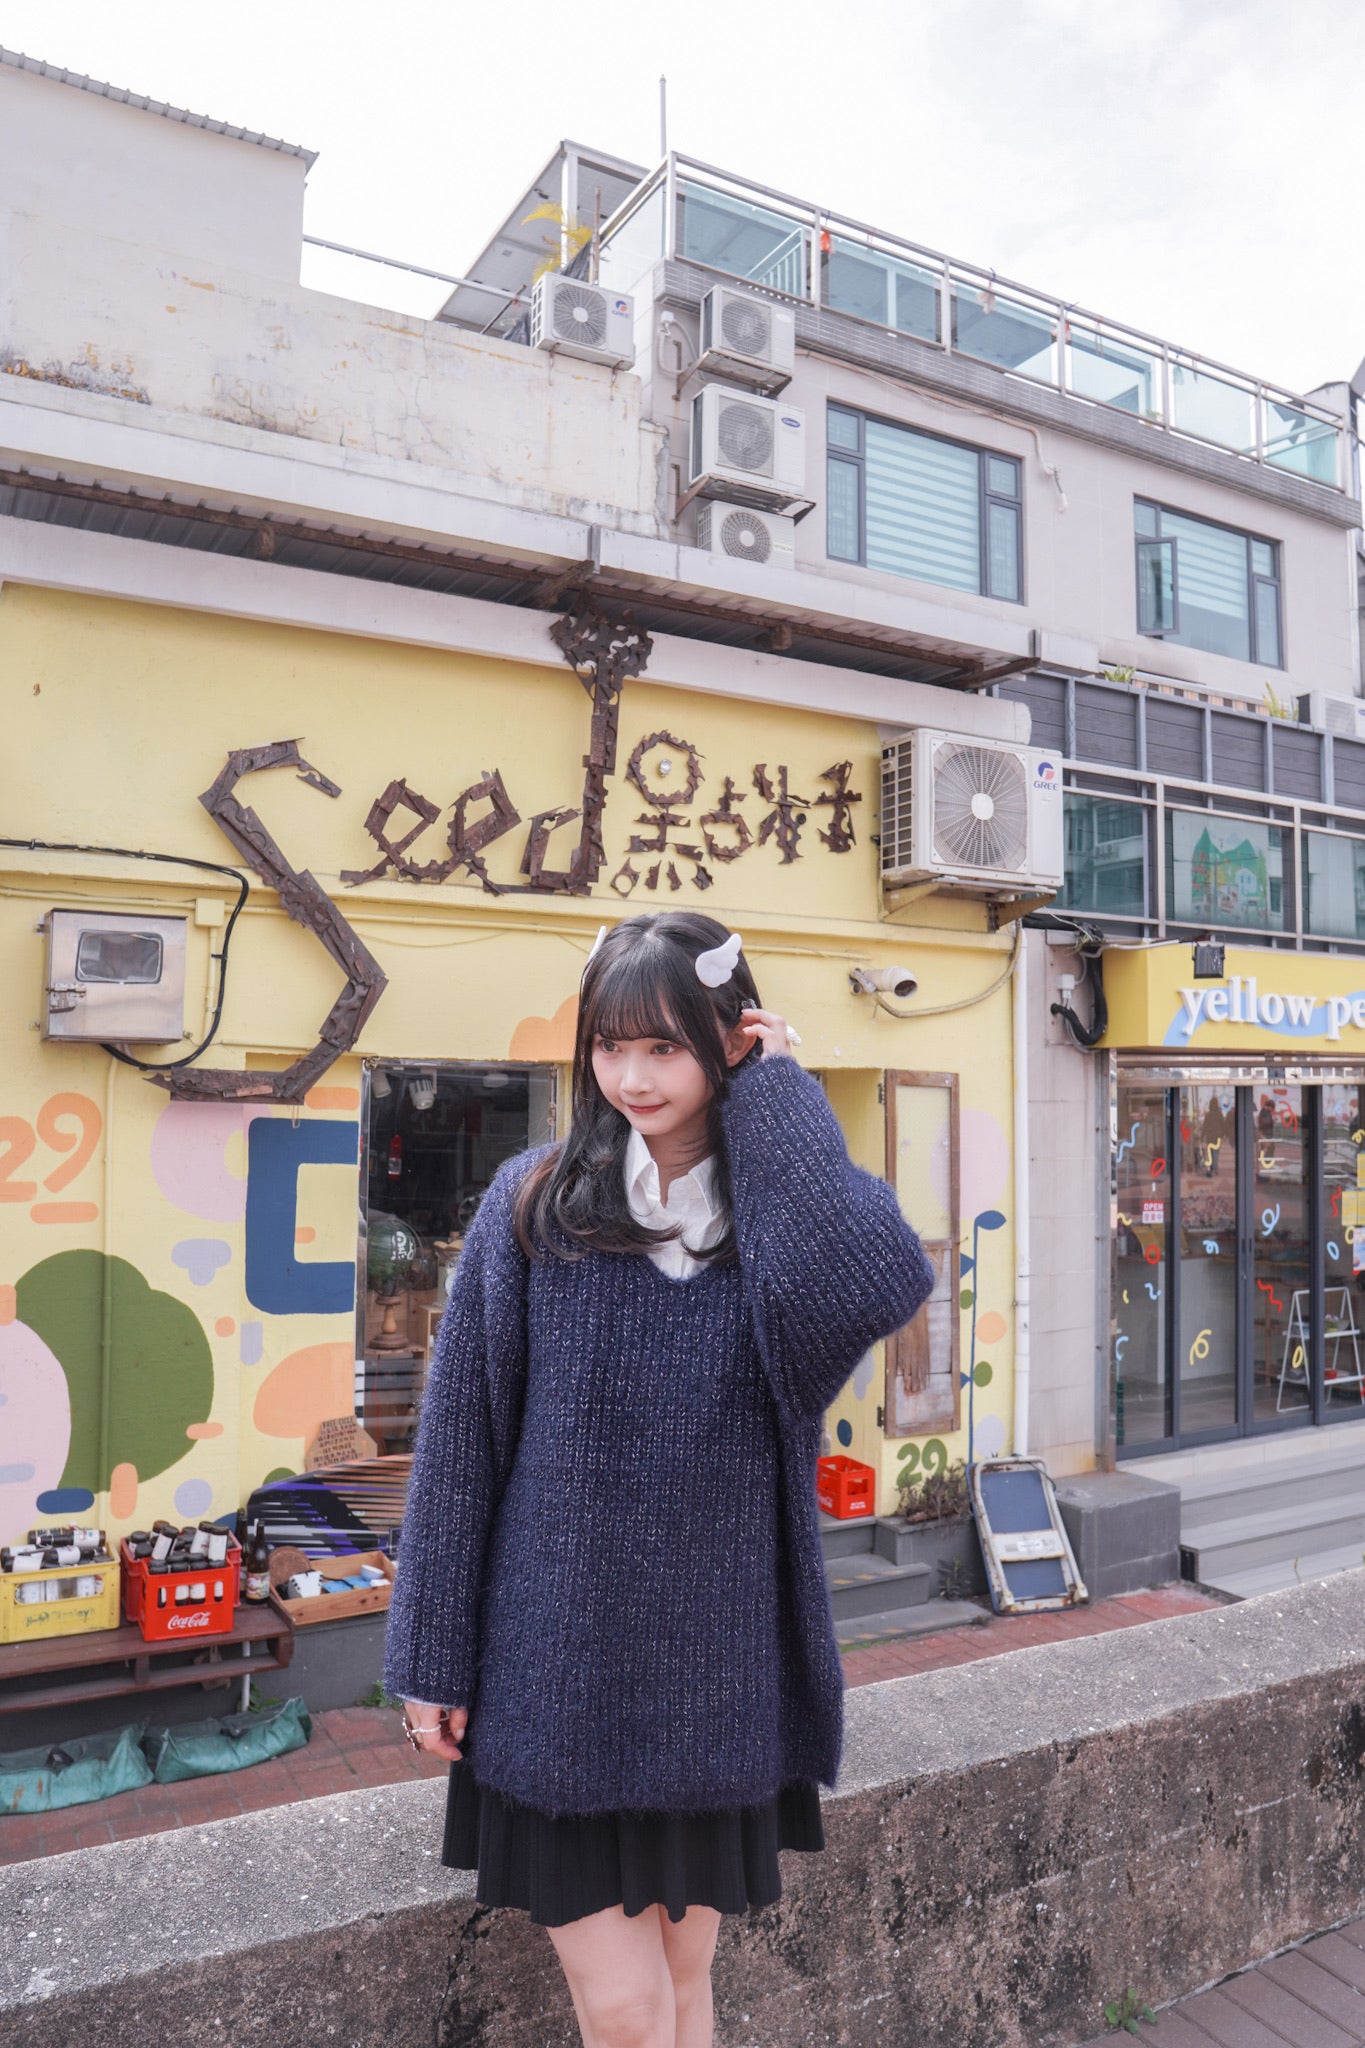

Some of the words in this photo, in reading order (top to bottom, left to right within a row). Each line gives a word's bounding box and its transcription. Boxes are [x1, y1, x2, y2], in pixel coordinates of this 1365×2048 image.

[1033, 780, 1060, 791] GREE
[143, 613, 653, 1106] Seed
[1178, 975, 1317, 1036] yellow
[1143, 1202, 1164, 1211] OPEN
[897, 1438, 948, 1489] 29
